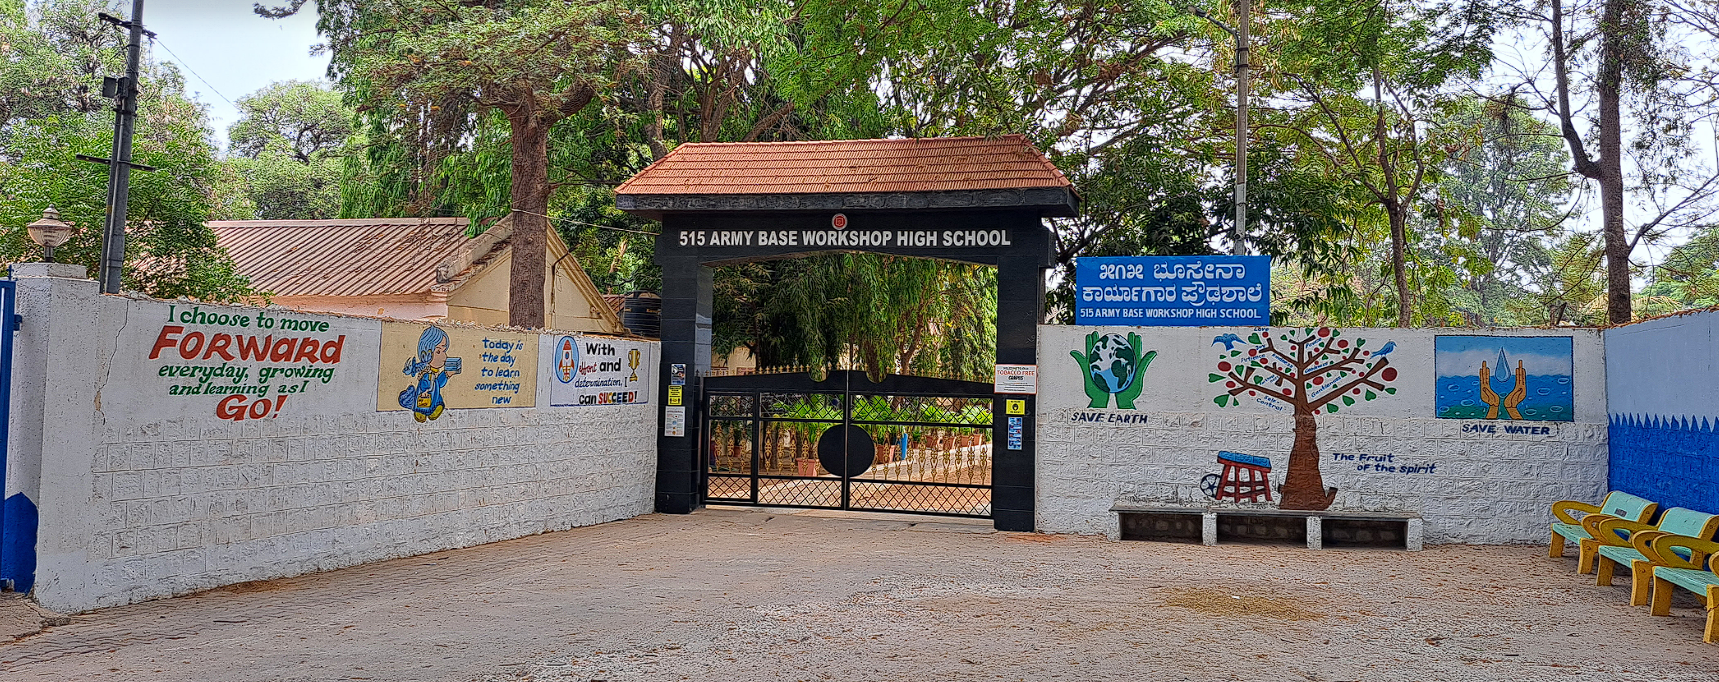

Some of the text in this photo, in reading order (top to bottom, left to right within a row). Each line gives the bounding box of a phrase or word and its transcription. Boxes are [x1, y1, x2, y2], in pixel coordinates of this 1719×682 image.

[679, 230, 1011, 247] 515 ARMY BASE WORKSHOP HIGH SCHOOL
[168, 305, 330, 333] I choose to move
[1080, 308, 1261, 319] 515 ARMY BASE WORKSHOP HIGH SCHOOL
[482, 336, 523, 353] today is
[585, 342, 616, 356] With
[481, 353, 517, 367] the day
[599, 357, 622, 372] and
[259, 365, 335, 384] growing
[481, 367, 520, 377] to learn
[474, 380, 520, 394] something
[624, 376, 628, 388] I
[169, 380, 309, 398] and learning as I
[491, 395, 511, 405] new
[578, 394, 597, 405] can
[1071, 411, 1148, 424] SAVE EARTH
[1461, 423, 1550, 435] SAVE WATER
[1333, 452, 1395, 463] The Fruit
[1374, 463, 1396, 473] the
[1399, 463, 1437, 475] spirit
